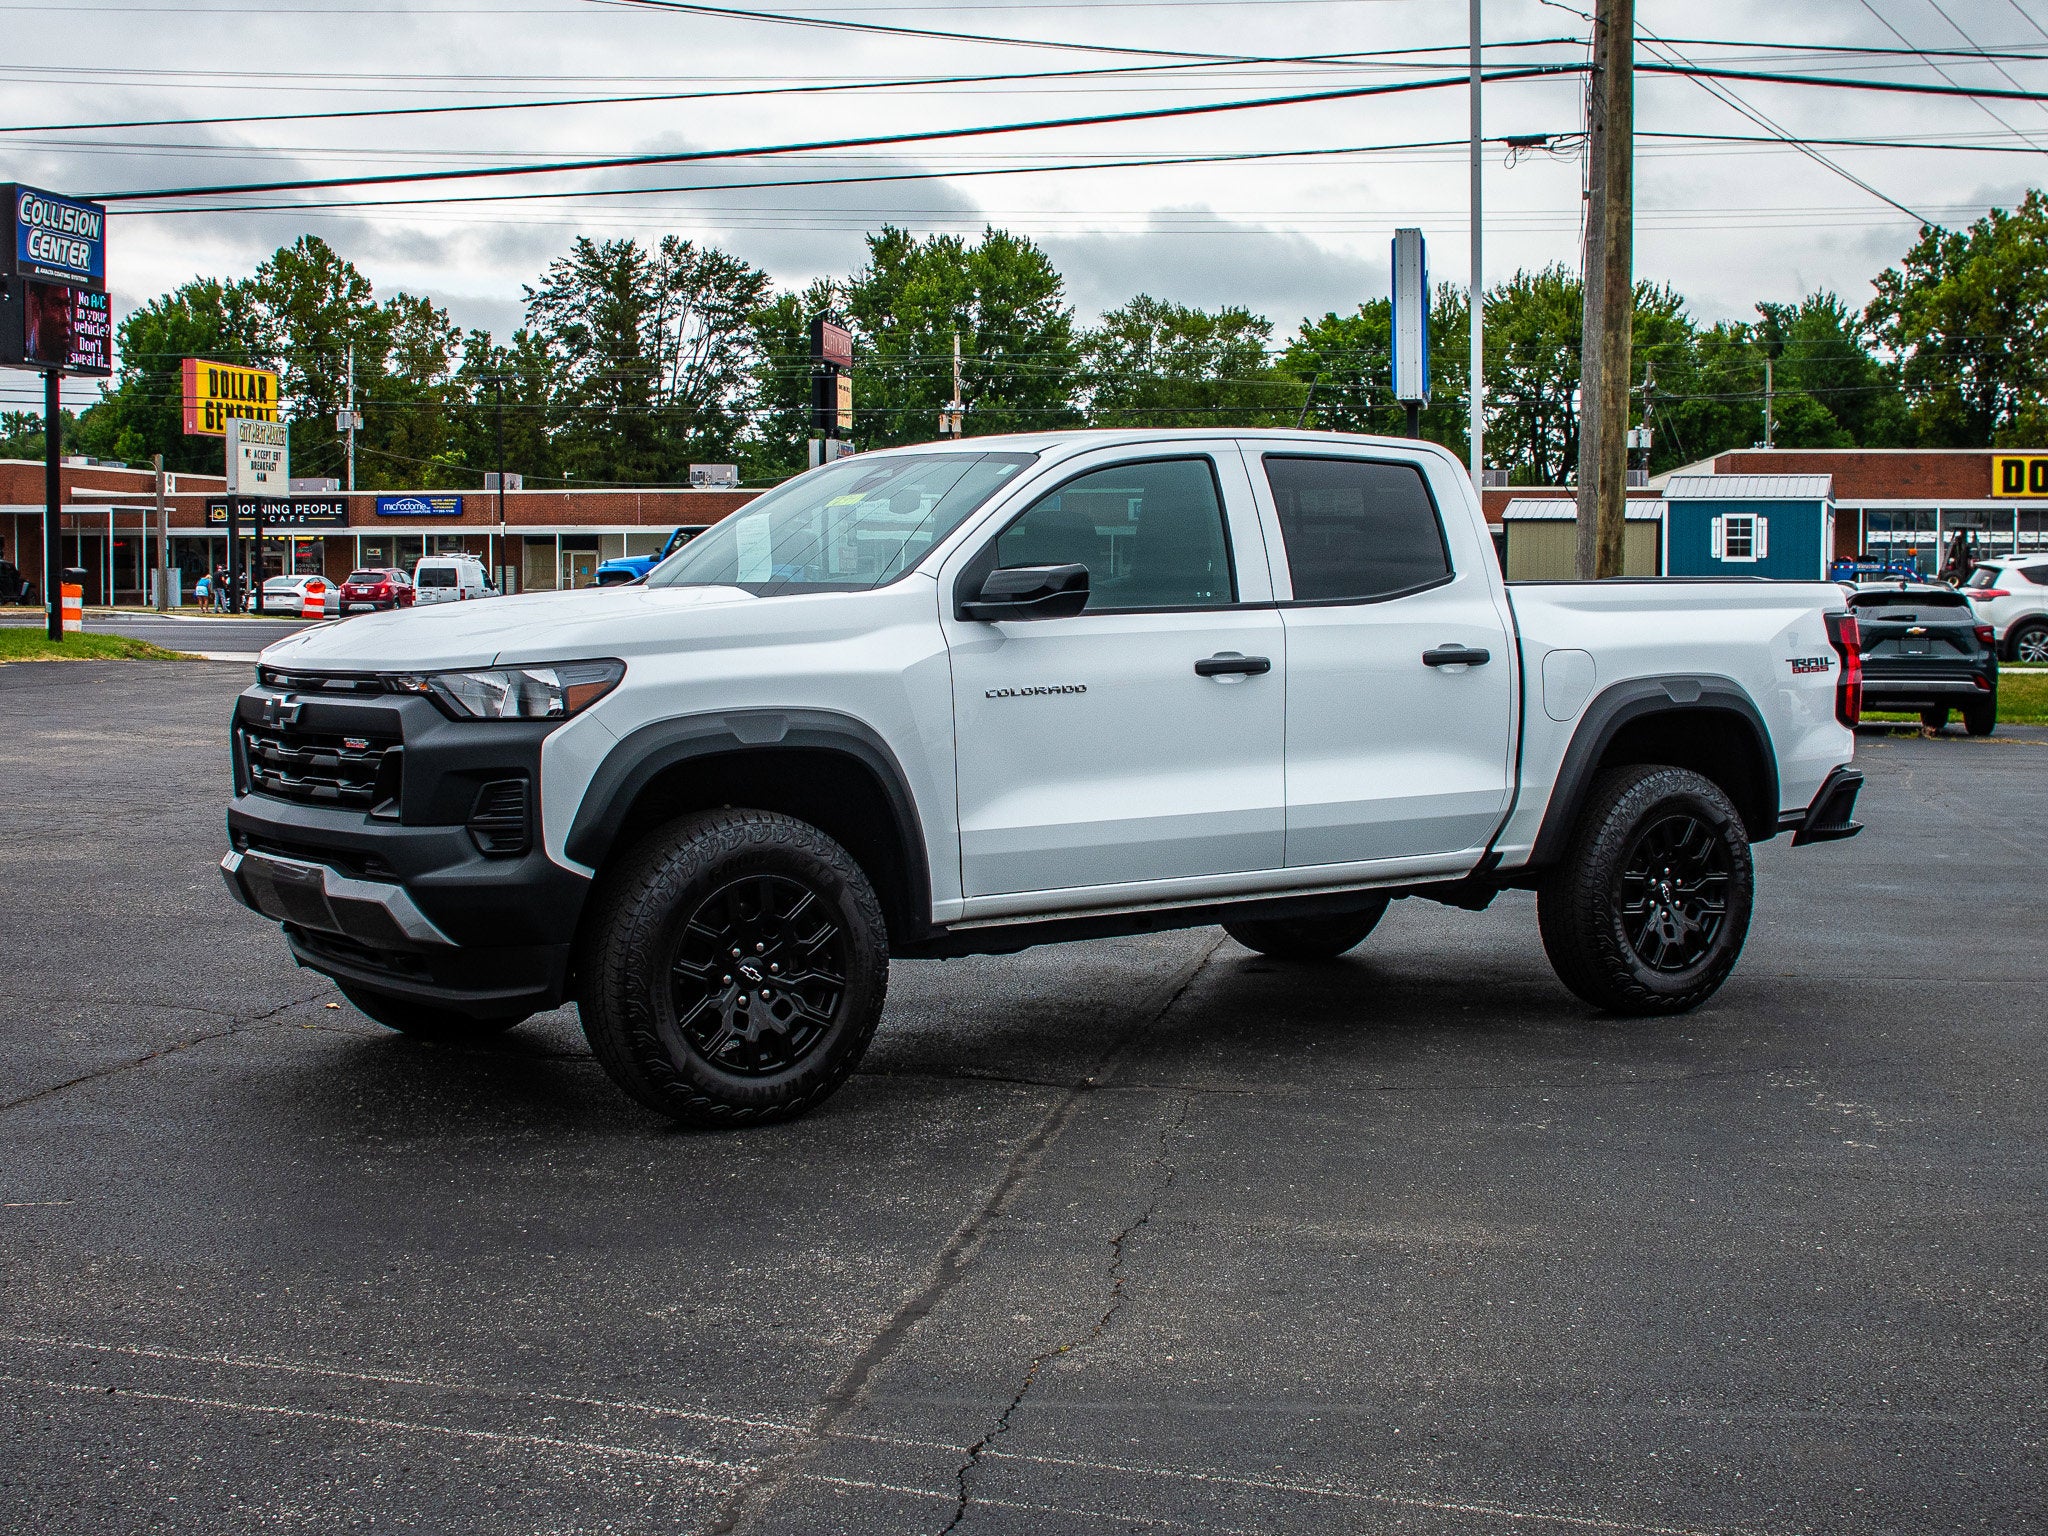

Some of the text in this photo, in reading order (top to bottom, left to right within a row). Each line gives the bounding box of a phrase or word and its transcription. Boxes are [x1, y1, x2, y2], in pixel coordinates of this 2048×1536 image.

[19, 192, 101, 240] COLLISION
[28, 228, 90, 269] CENTER
[78, 291, 89, 306] No
[77, 305, 107, 323] in your
[74, 320, 110, 338] vehicle?
[79, 336, 102, 353] Don't
[70, 352, 95, 367] sweat
[209, 368, 267, 404] DOLLAR
[254, 449, 271, 460] ACCEPT
[251, 460, 277, 472] BREAKFAST
[237, 504, 343, 514] ORNING PEOPLE
[383, 501, 427, 511] microdome
[269, 515, 305, 523] CAFE
[1785, 656, 1835, 668] TRAIL
[1792, 664, 1830, 675] BOSS
[985, 684, 1087, 699] COLORADO
